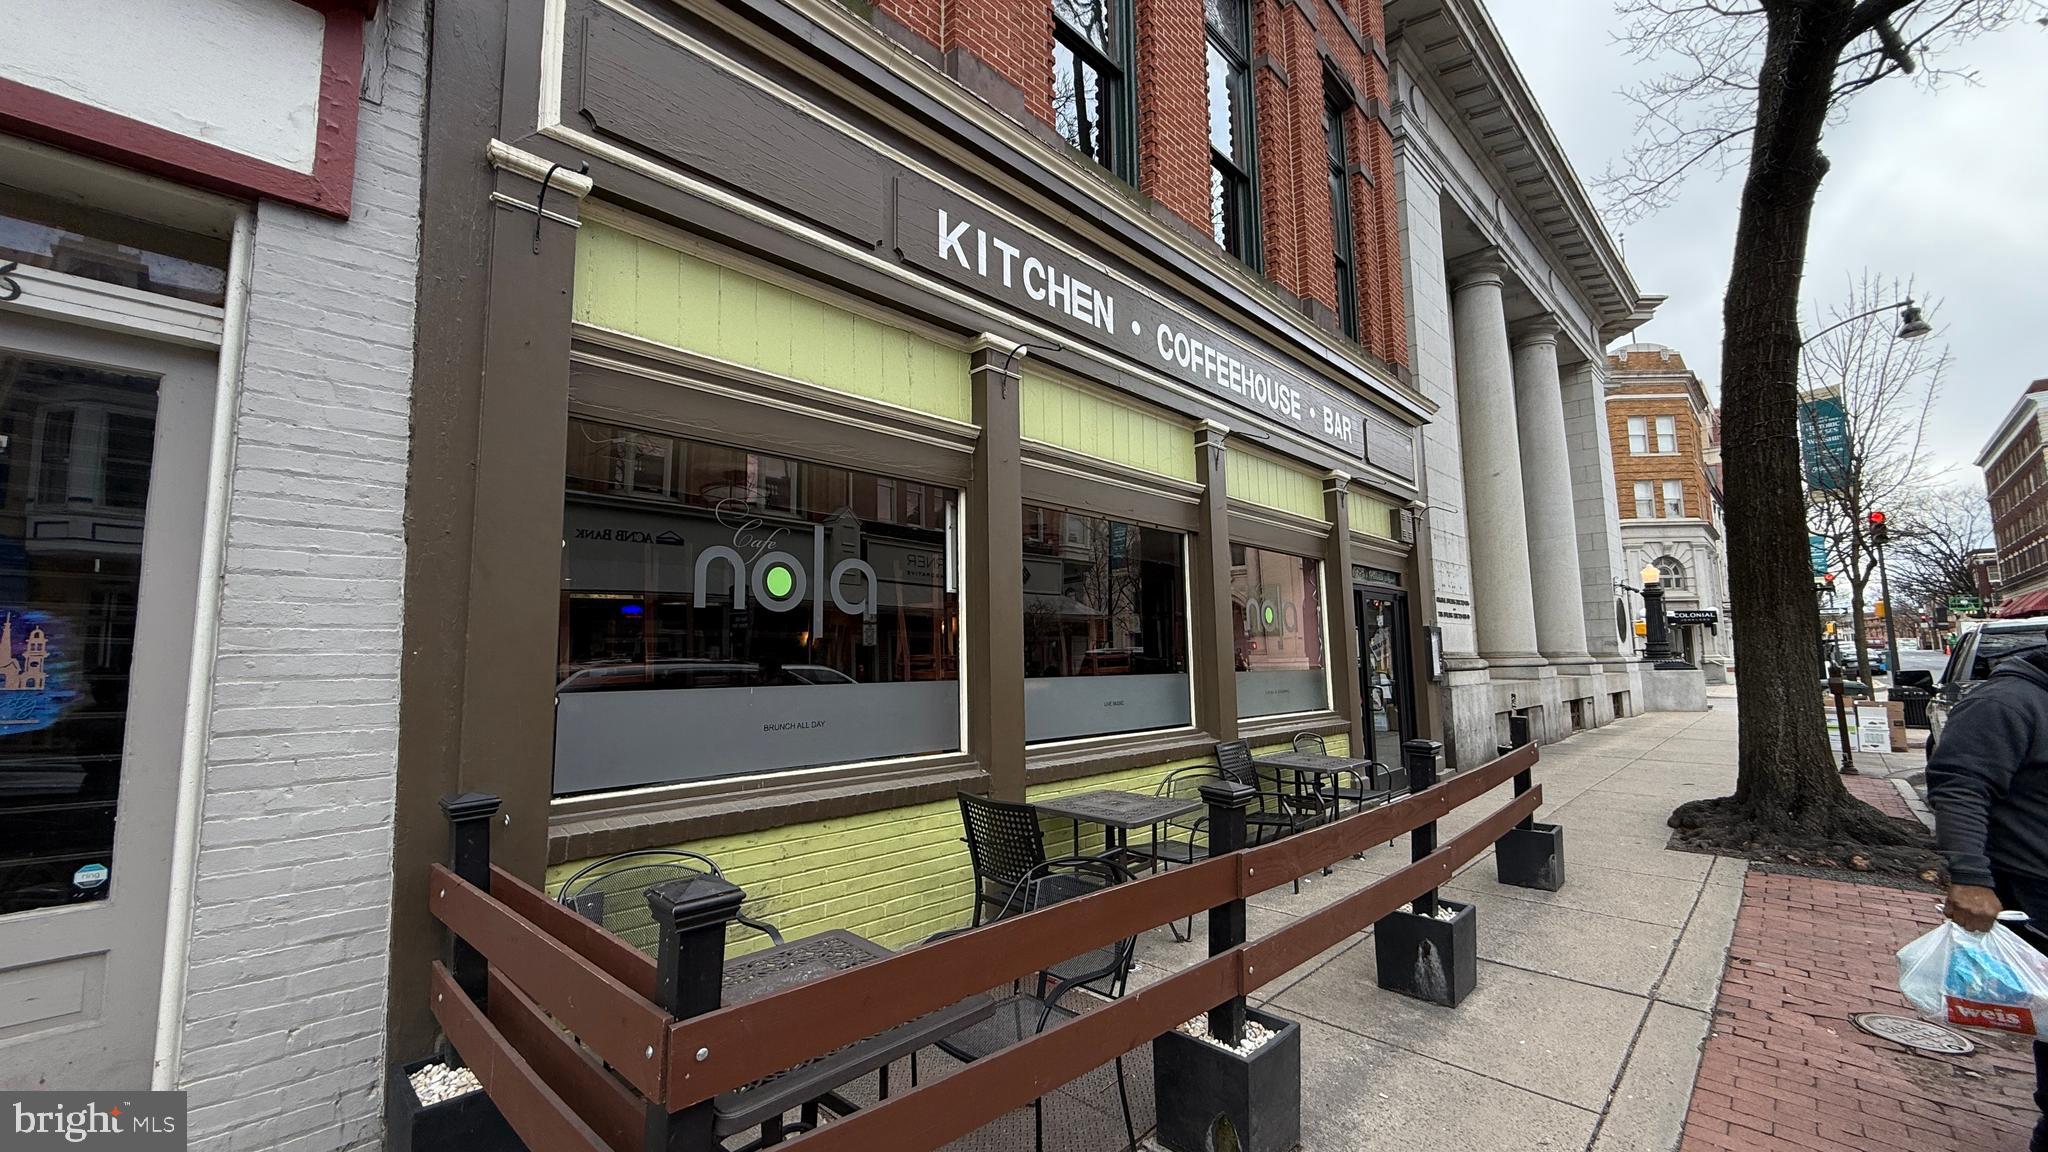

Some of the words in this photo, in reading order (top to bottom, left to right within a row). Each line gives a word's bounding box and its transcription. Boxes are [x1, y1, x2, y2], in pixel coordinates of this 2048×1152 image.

[938, 208, 1114, 335] KITCHEN
[1157, 323, 1301, 421] COFFEEHOUSE
[1323, 405, 1353, 444] BAR
[715, 498, 791, 566] Cafe
[694, 525, 877, 638] nola
[1245, 584, 1298, 650] nola
[763, 722, 796, 732] BRUNCH
[811, 720, 826, 729] DAY
[1955, 1005, 2021, 1025] weis
